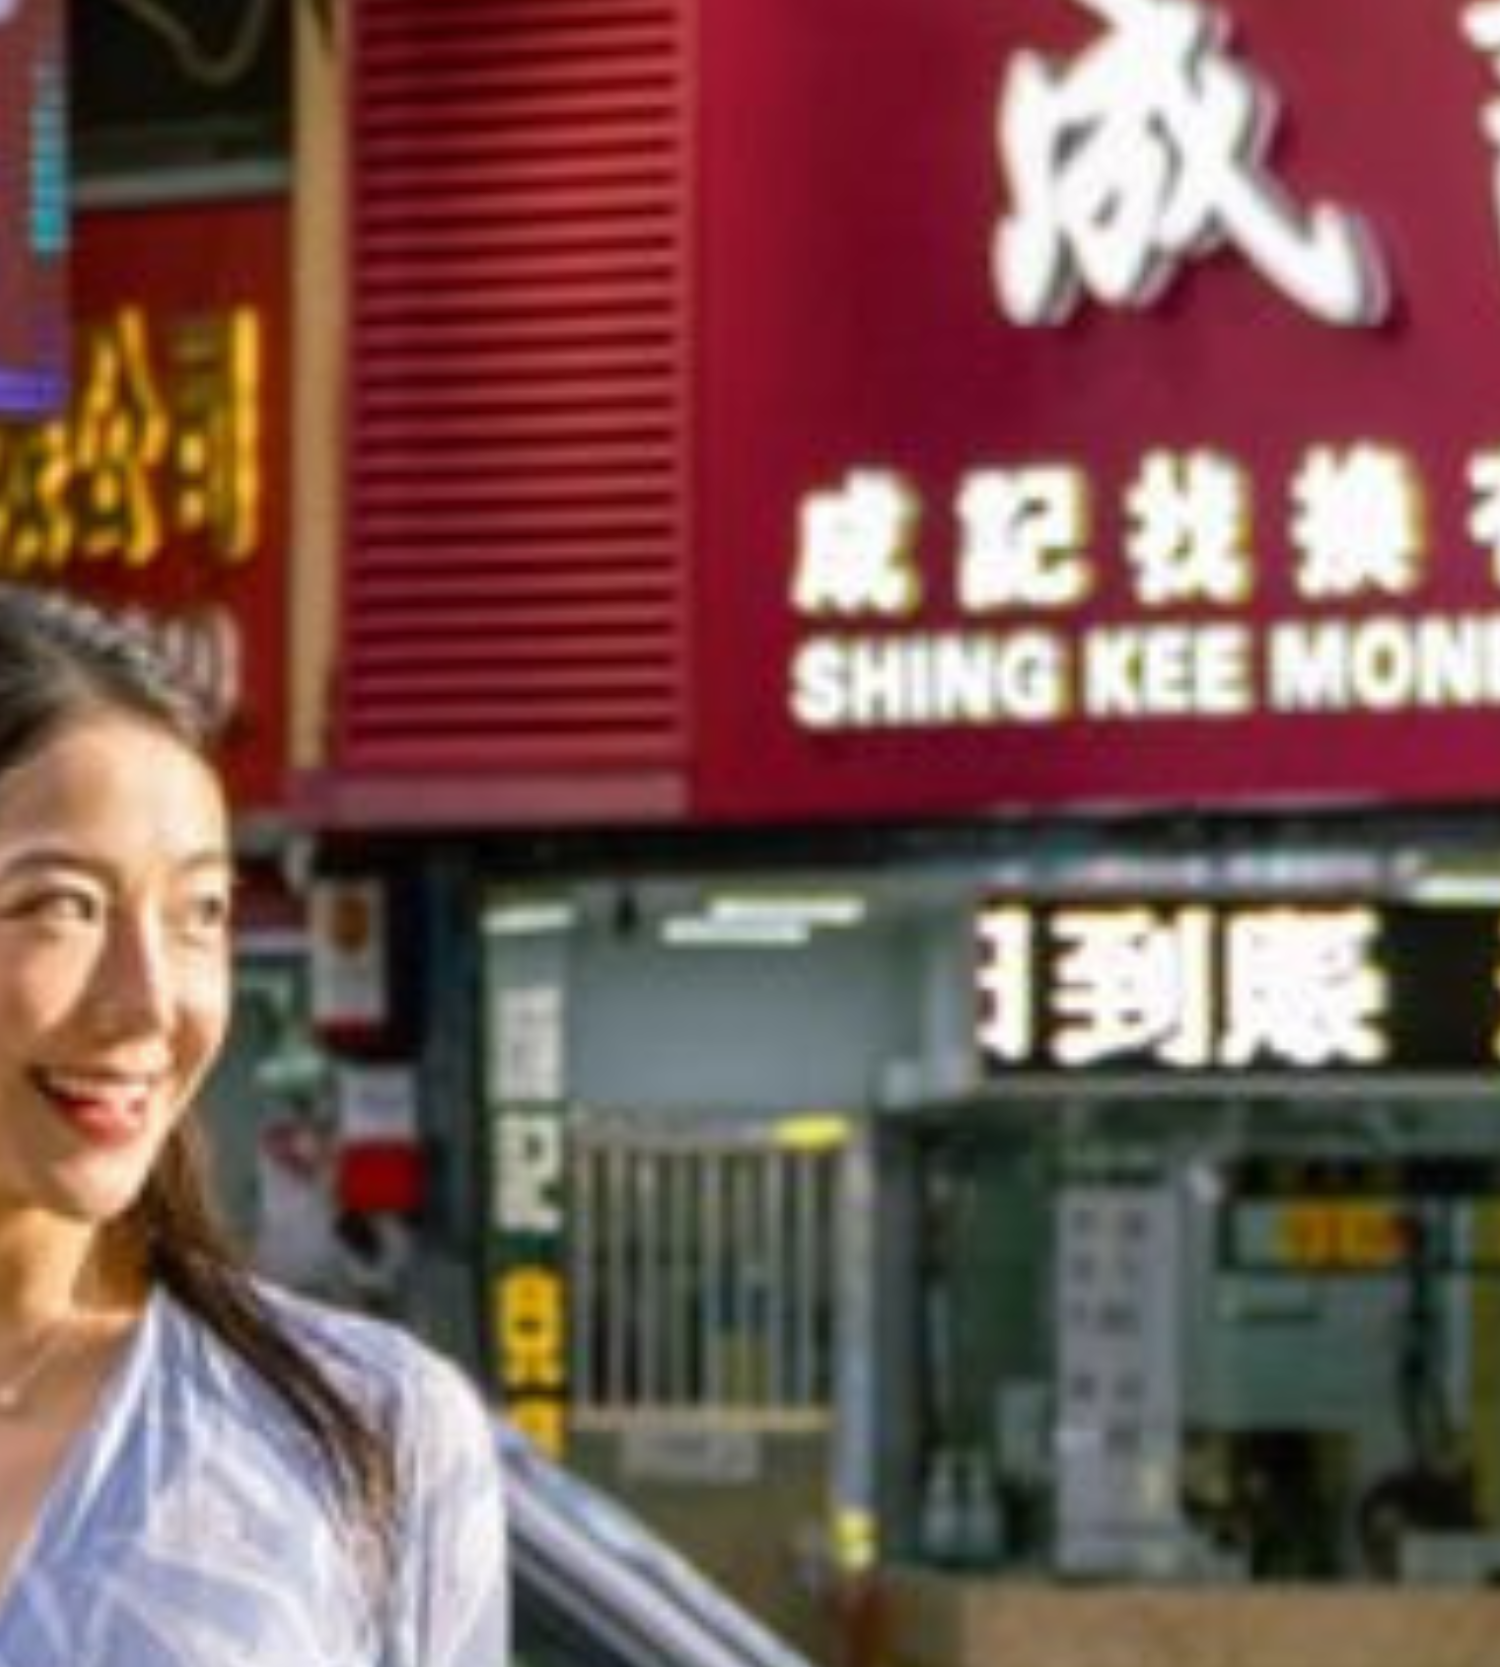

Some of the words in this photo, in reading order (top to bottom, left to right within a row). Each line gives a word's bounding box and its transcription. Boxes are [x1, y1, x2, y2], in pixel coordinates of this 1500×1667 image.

[990, 0, 1500, 325] 成
[791, 440, 1500, 614] 成記找換
[790, 630, 1070, 728] SHING
[1081, 622, 1254, 714] KEE
